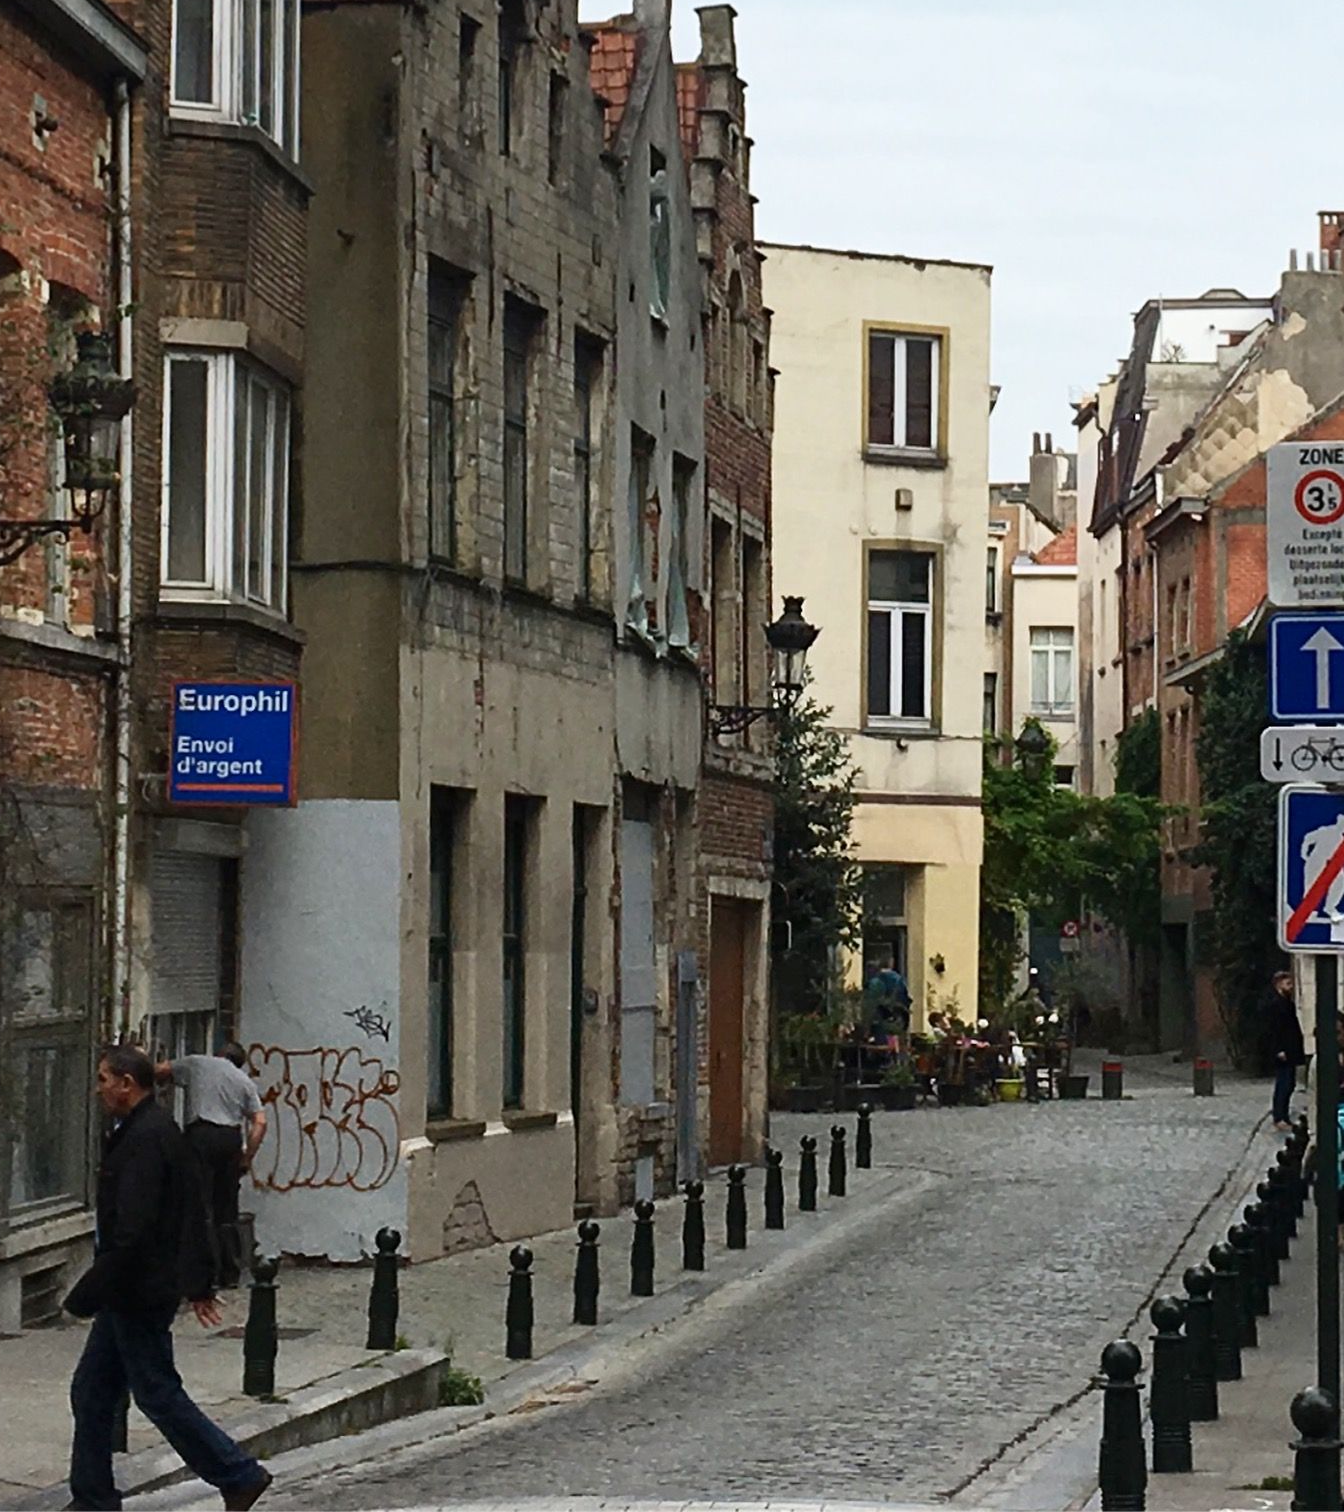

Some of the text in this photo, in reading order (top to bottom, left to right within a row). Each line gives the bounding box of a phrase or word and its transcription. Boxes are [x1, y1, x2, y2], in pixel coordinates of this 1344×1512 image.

[1299, 448, 1344, 465] ZONE
[1284, 543, 1328, 555] desserte
[178, 689, 288, 716] Europhil
[177, 736, 234, 753] Envoi
[177, 756, 262, 778] d'argent
